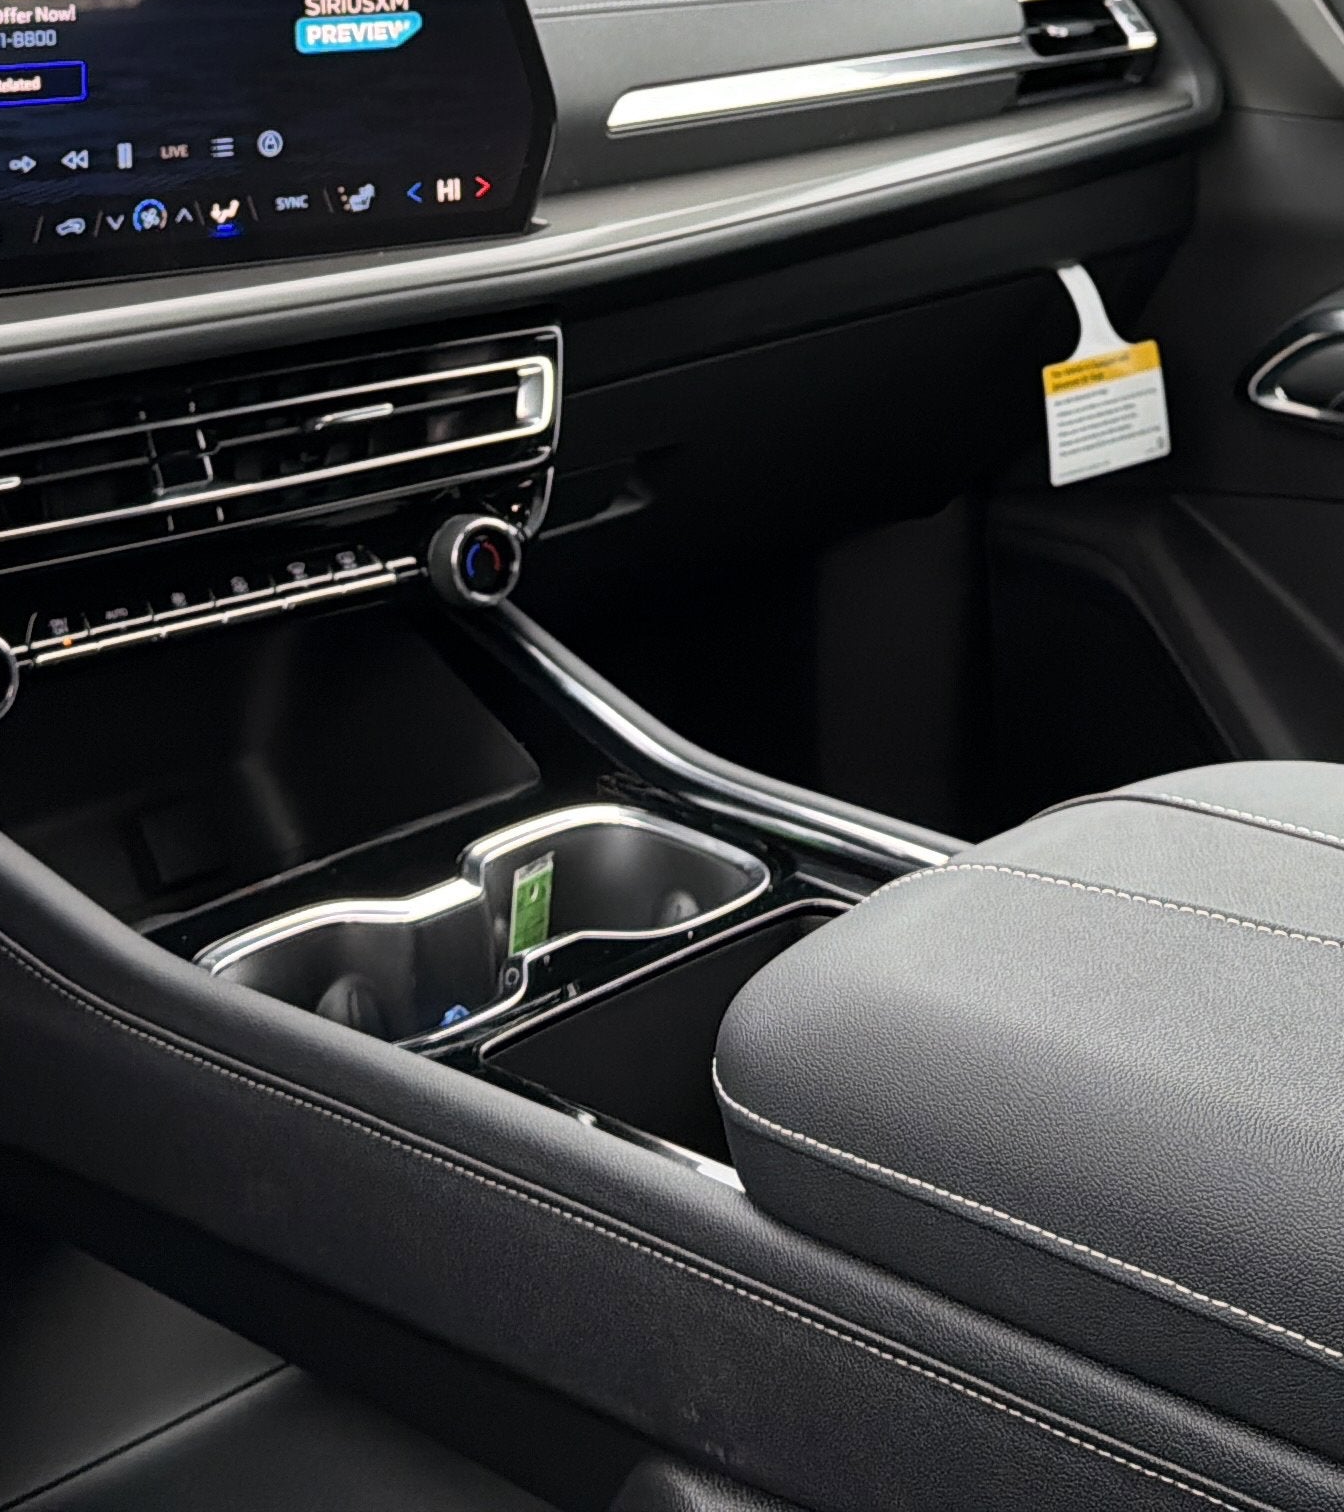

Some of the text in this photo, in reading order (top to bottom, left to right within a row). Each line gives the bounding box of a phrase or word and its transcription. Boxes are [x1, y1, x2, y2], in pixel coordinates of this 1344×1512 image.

[36, 4, 76, 24] Now!
[306, 19, 411, 46] PREVIEW
[160, 144, 189, 160] LIVE
[275, 194, 309, 211] SYNC
